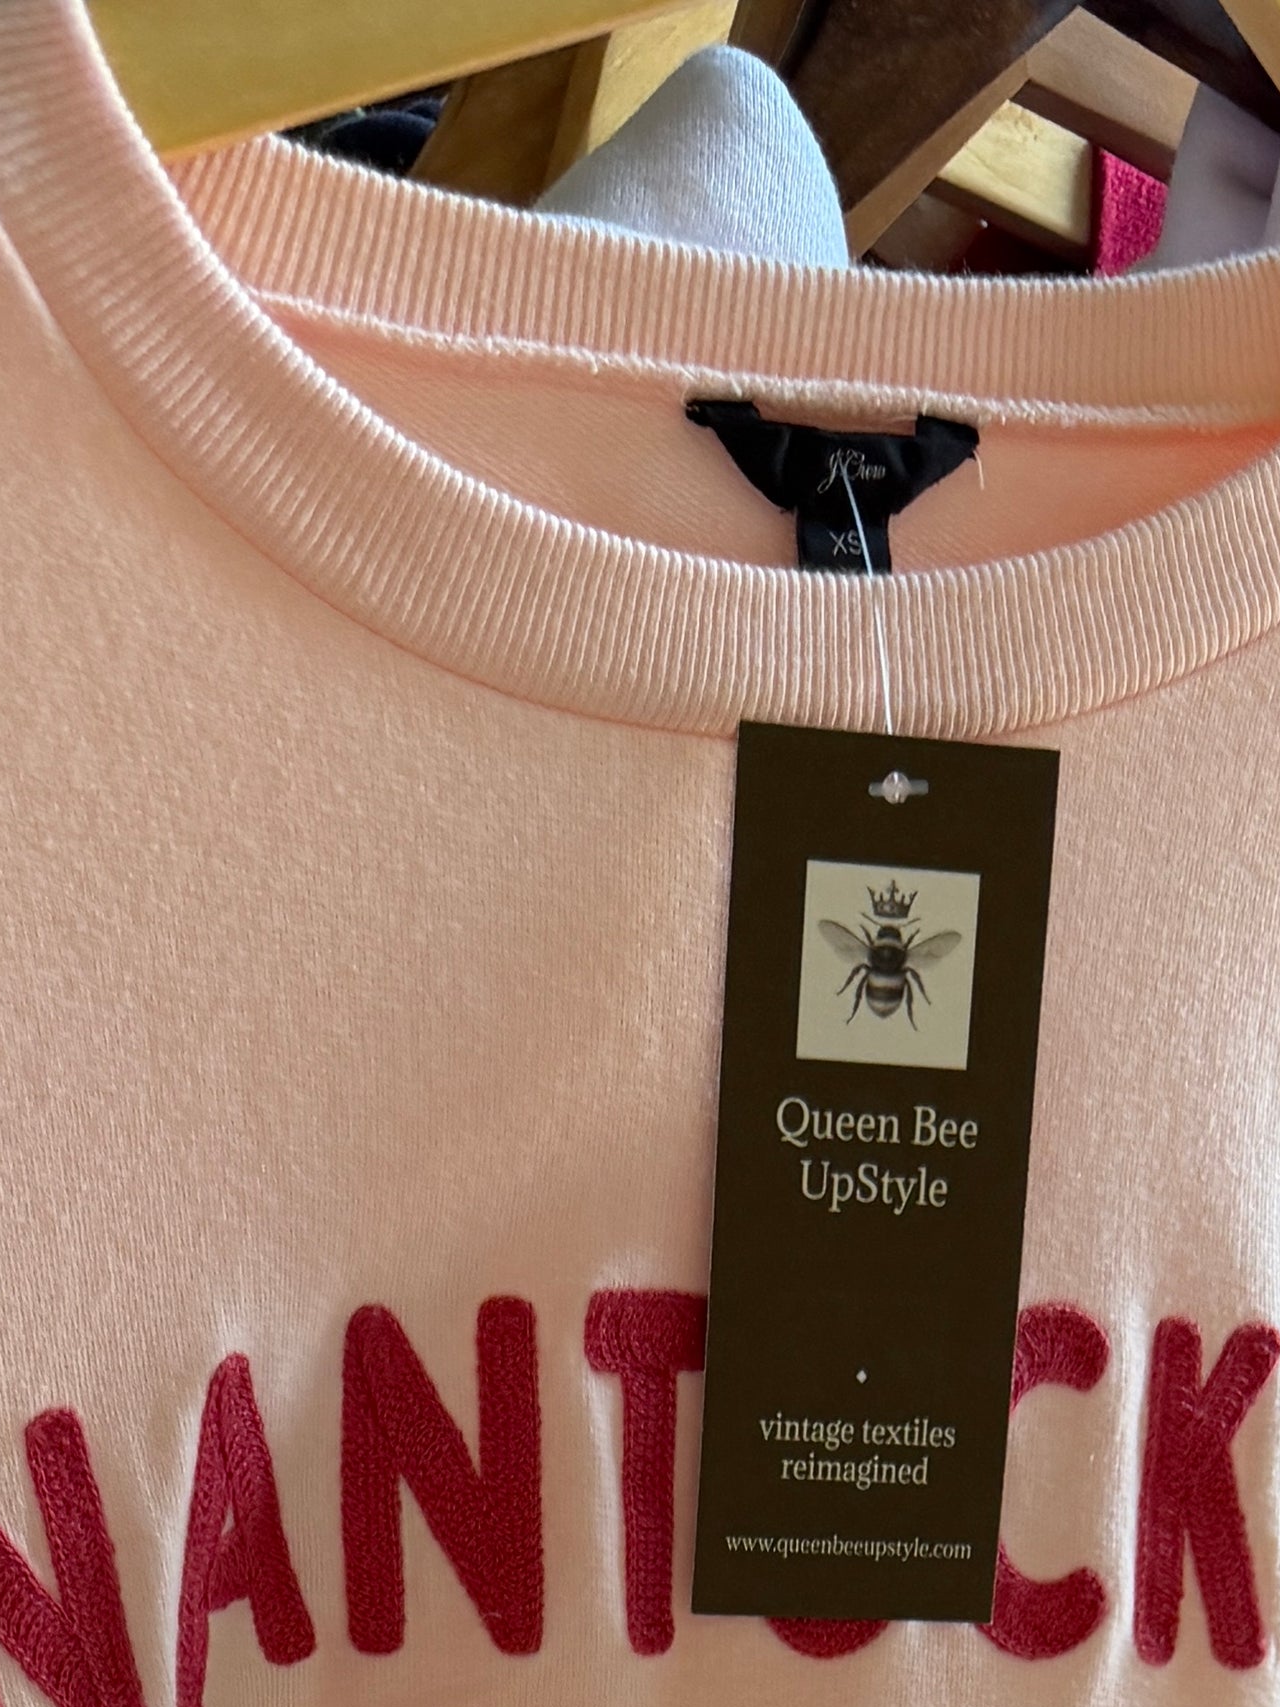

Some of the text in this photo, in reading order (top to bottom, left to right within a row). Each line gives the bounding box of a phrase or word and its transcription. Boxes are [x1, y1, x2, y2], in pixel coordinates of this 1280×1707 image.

[828, 529, 863, 558] XS
[776, 1097, 979, 1150] Queen Bee
[800, 1159, 949, 1216] UpStyle
[759, 1412, 957, 1452] vintage textiles
[780, 1452, 929, 1491] reimagined
[725, 1534, 973, 1563] www.queenbeeupstyle.com
